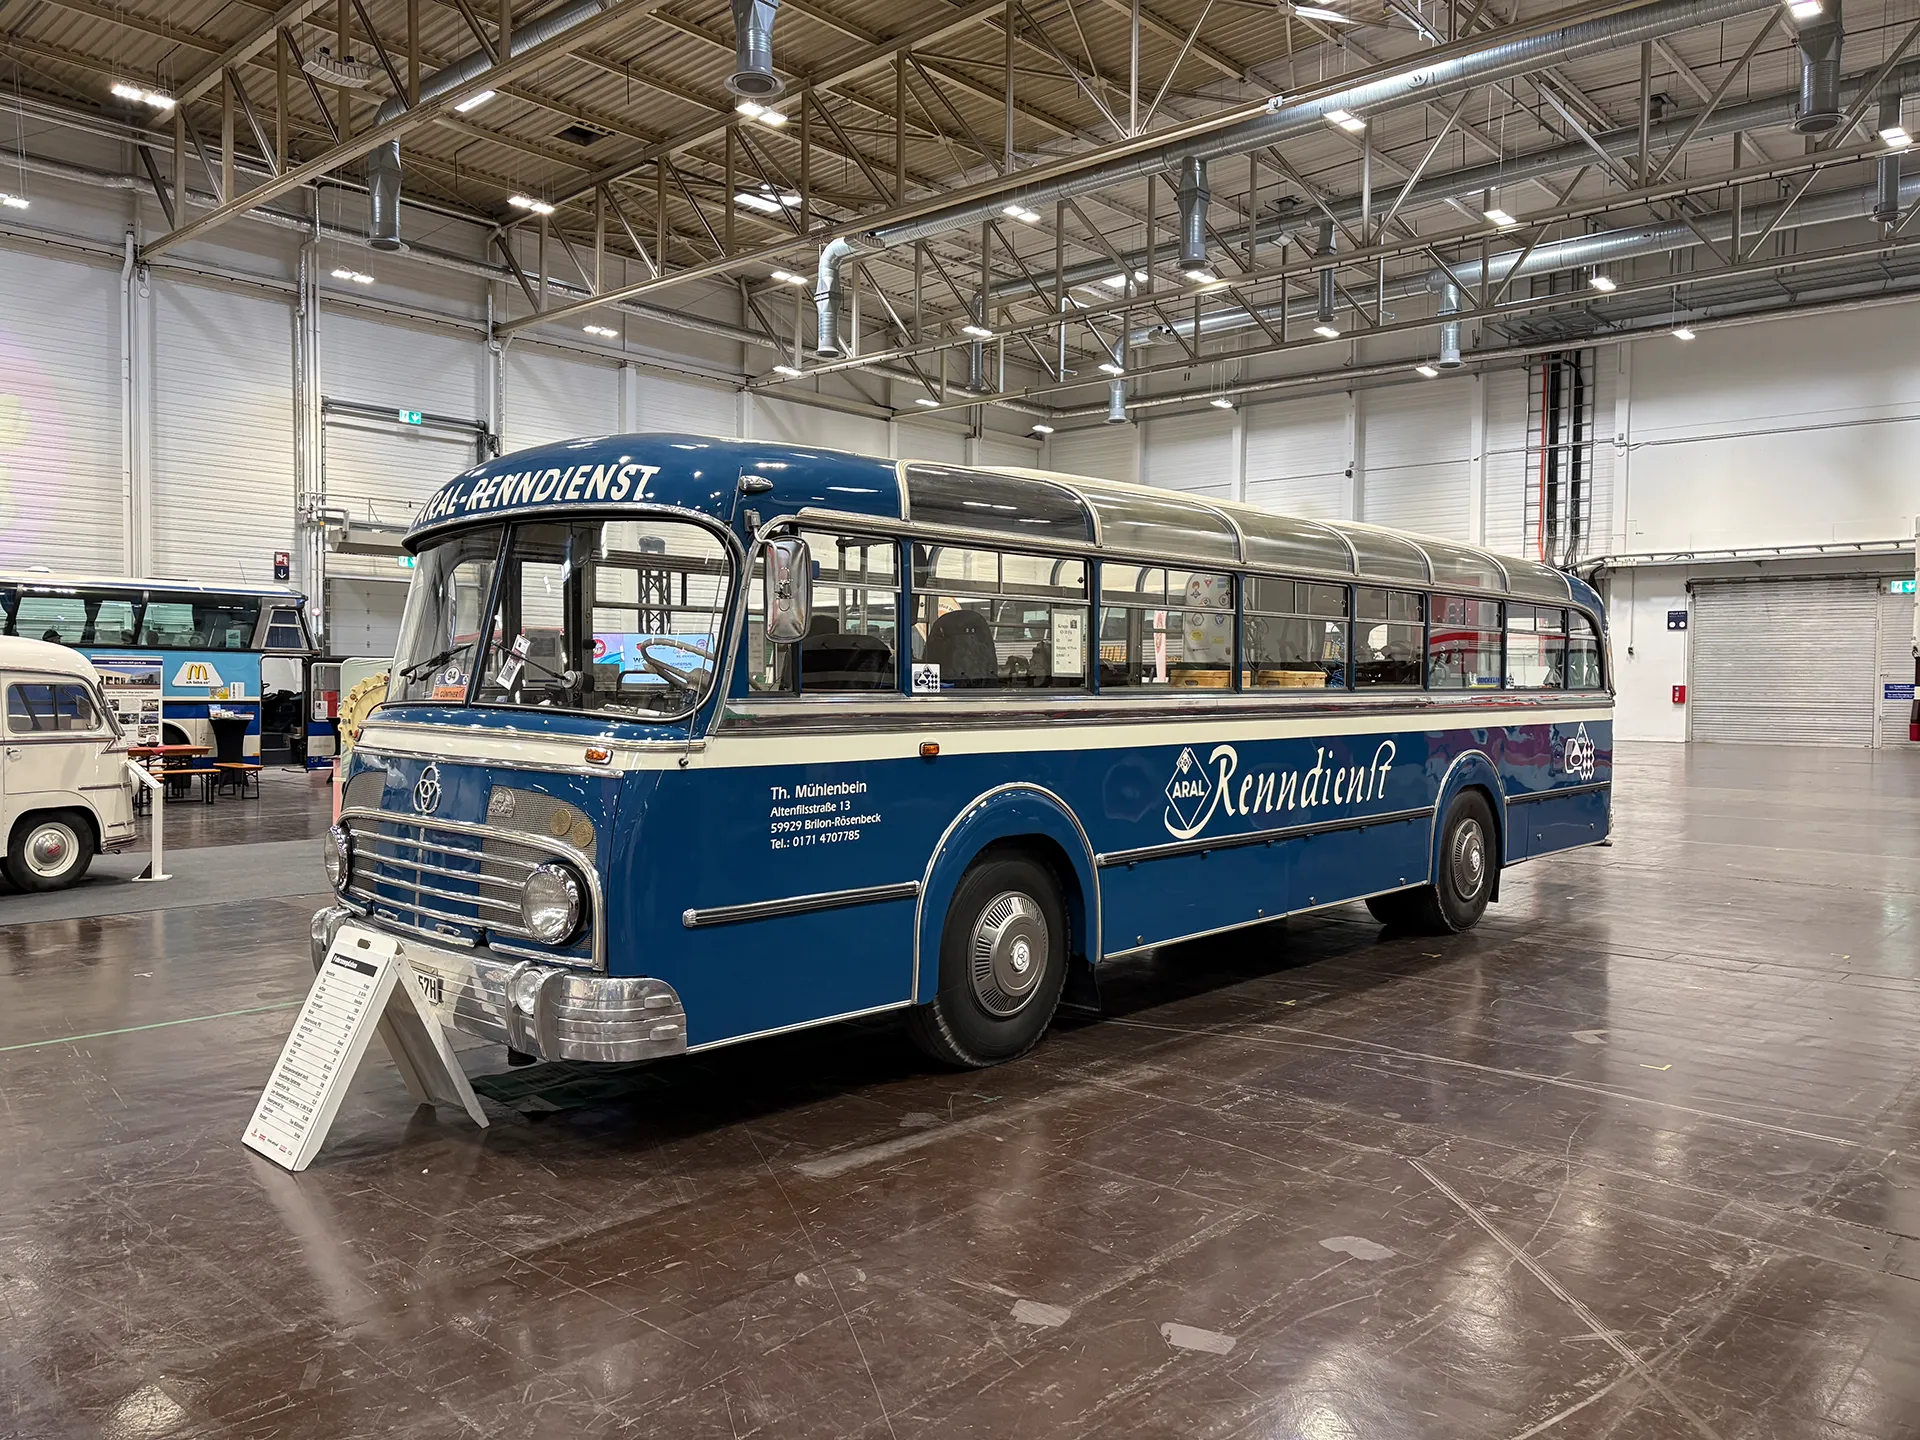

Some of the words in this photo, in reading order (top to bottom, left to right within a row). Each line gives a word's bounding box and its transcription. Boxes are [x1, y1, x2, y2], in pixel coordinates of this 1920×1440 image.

[447, 671, 457, 681] 94
[770, 786, 791, 800] Th.
[795, 781, 867, 798] Mühlenbein
[1172, 779, 1205, 799] ARAL
[770, 802, 837, 818] Altenfilsstraße
[840, 800, 851, 811] 13
[770, 820, 802, 834] 59929
[804, 813, 881, 830] Brilon-Rösenbeck
[770, 838, 790, 850] Tel.:
[792, 834, 816, 847] 0171
[819, 829, 860, 843] 4707785
